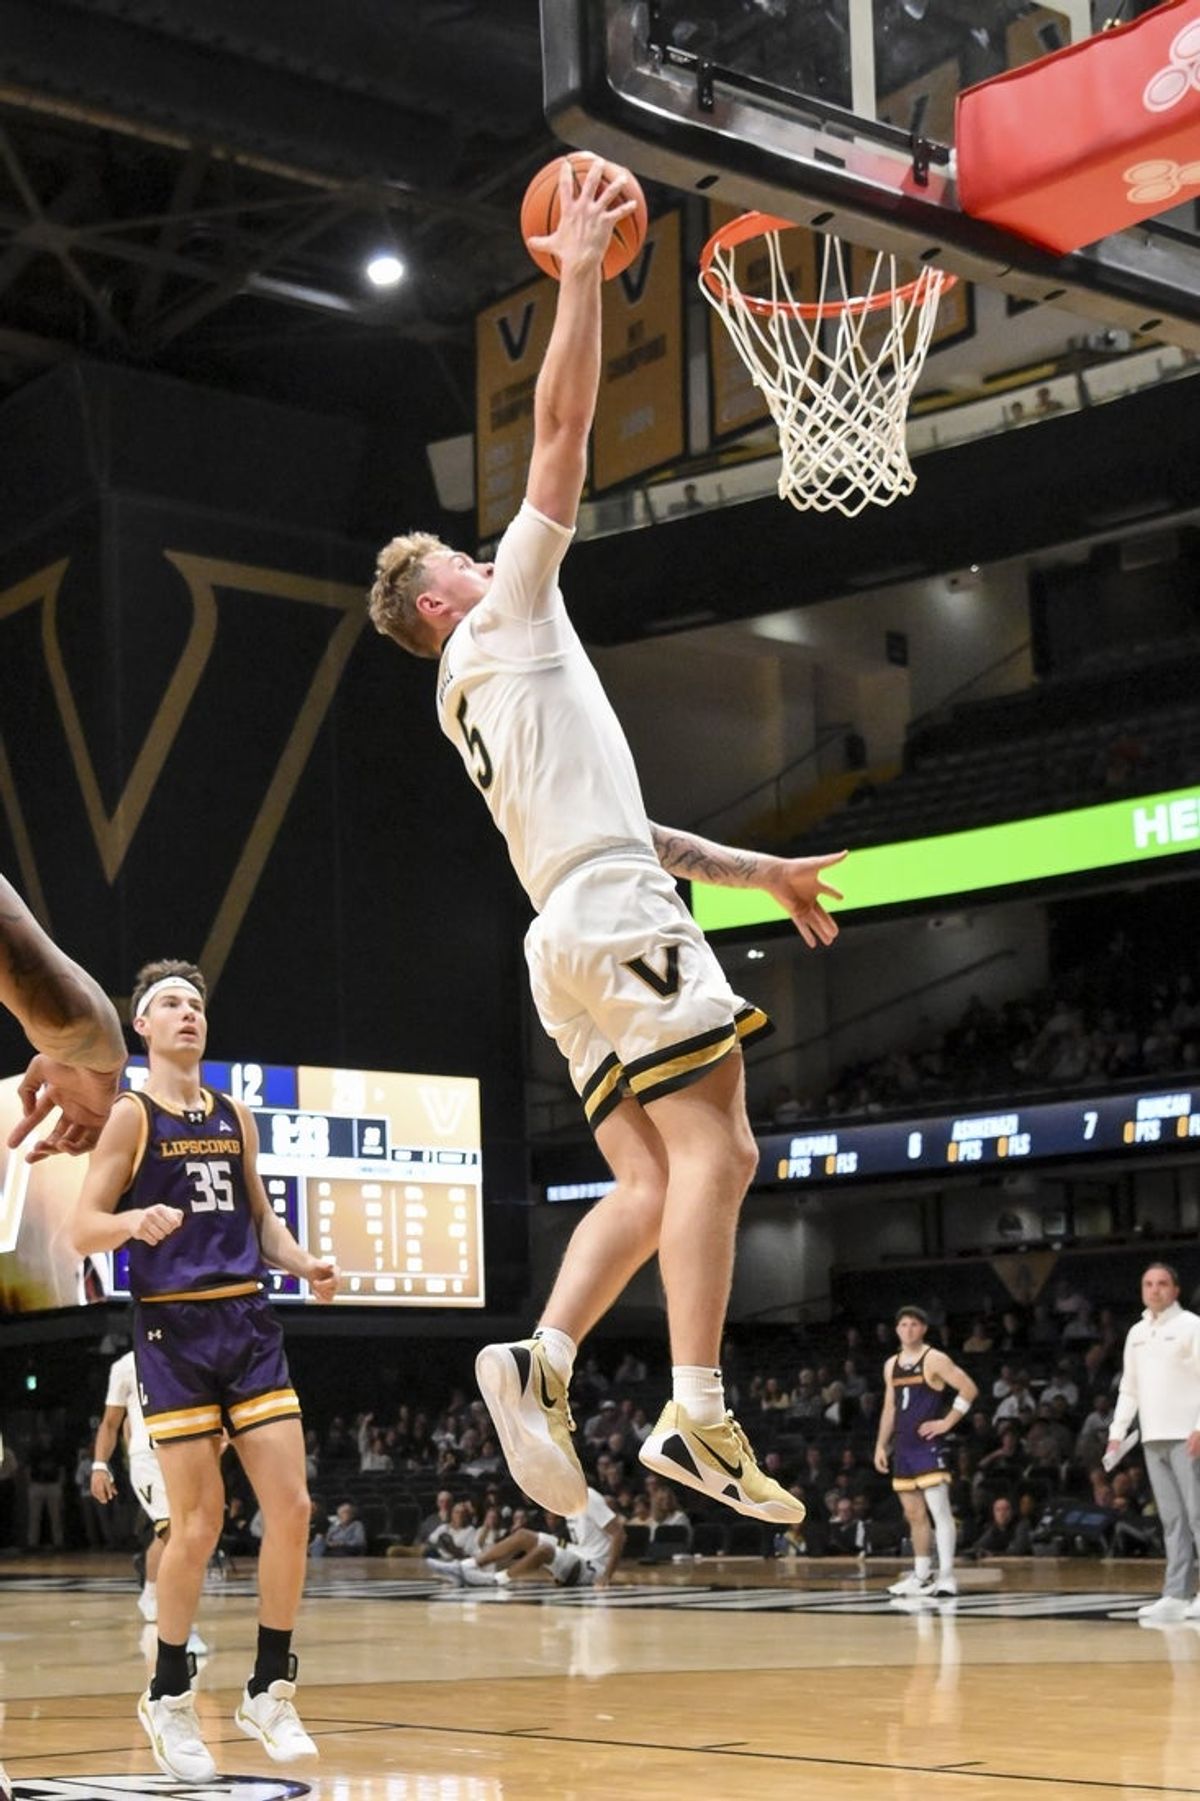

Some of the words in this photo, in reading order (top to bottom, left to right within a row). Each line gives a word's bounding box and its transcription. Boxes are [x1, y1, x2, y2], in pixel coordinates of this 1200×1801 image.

[497, 302, 535, 363] V
[456, 690, 494, 790] 5
[1132, 797, 1200, 849] HE
[619, 943, 681, 1003] V
[231, 1063, 263, 1107] 12
[160, 1139, 241, 1157] LIPSCOMB
[1083, 1111, 1098, 1140] 7
[185, 1161, 235, 1213] 35
